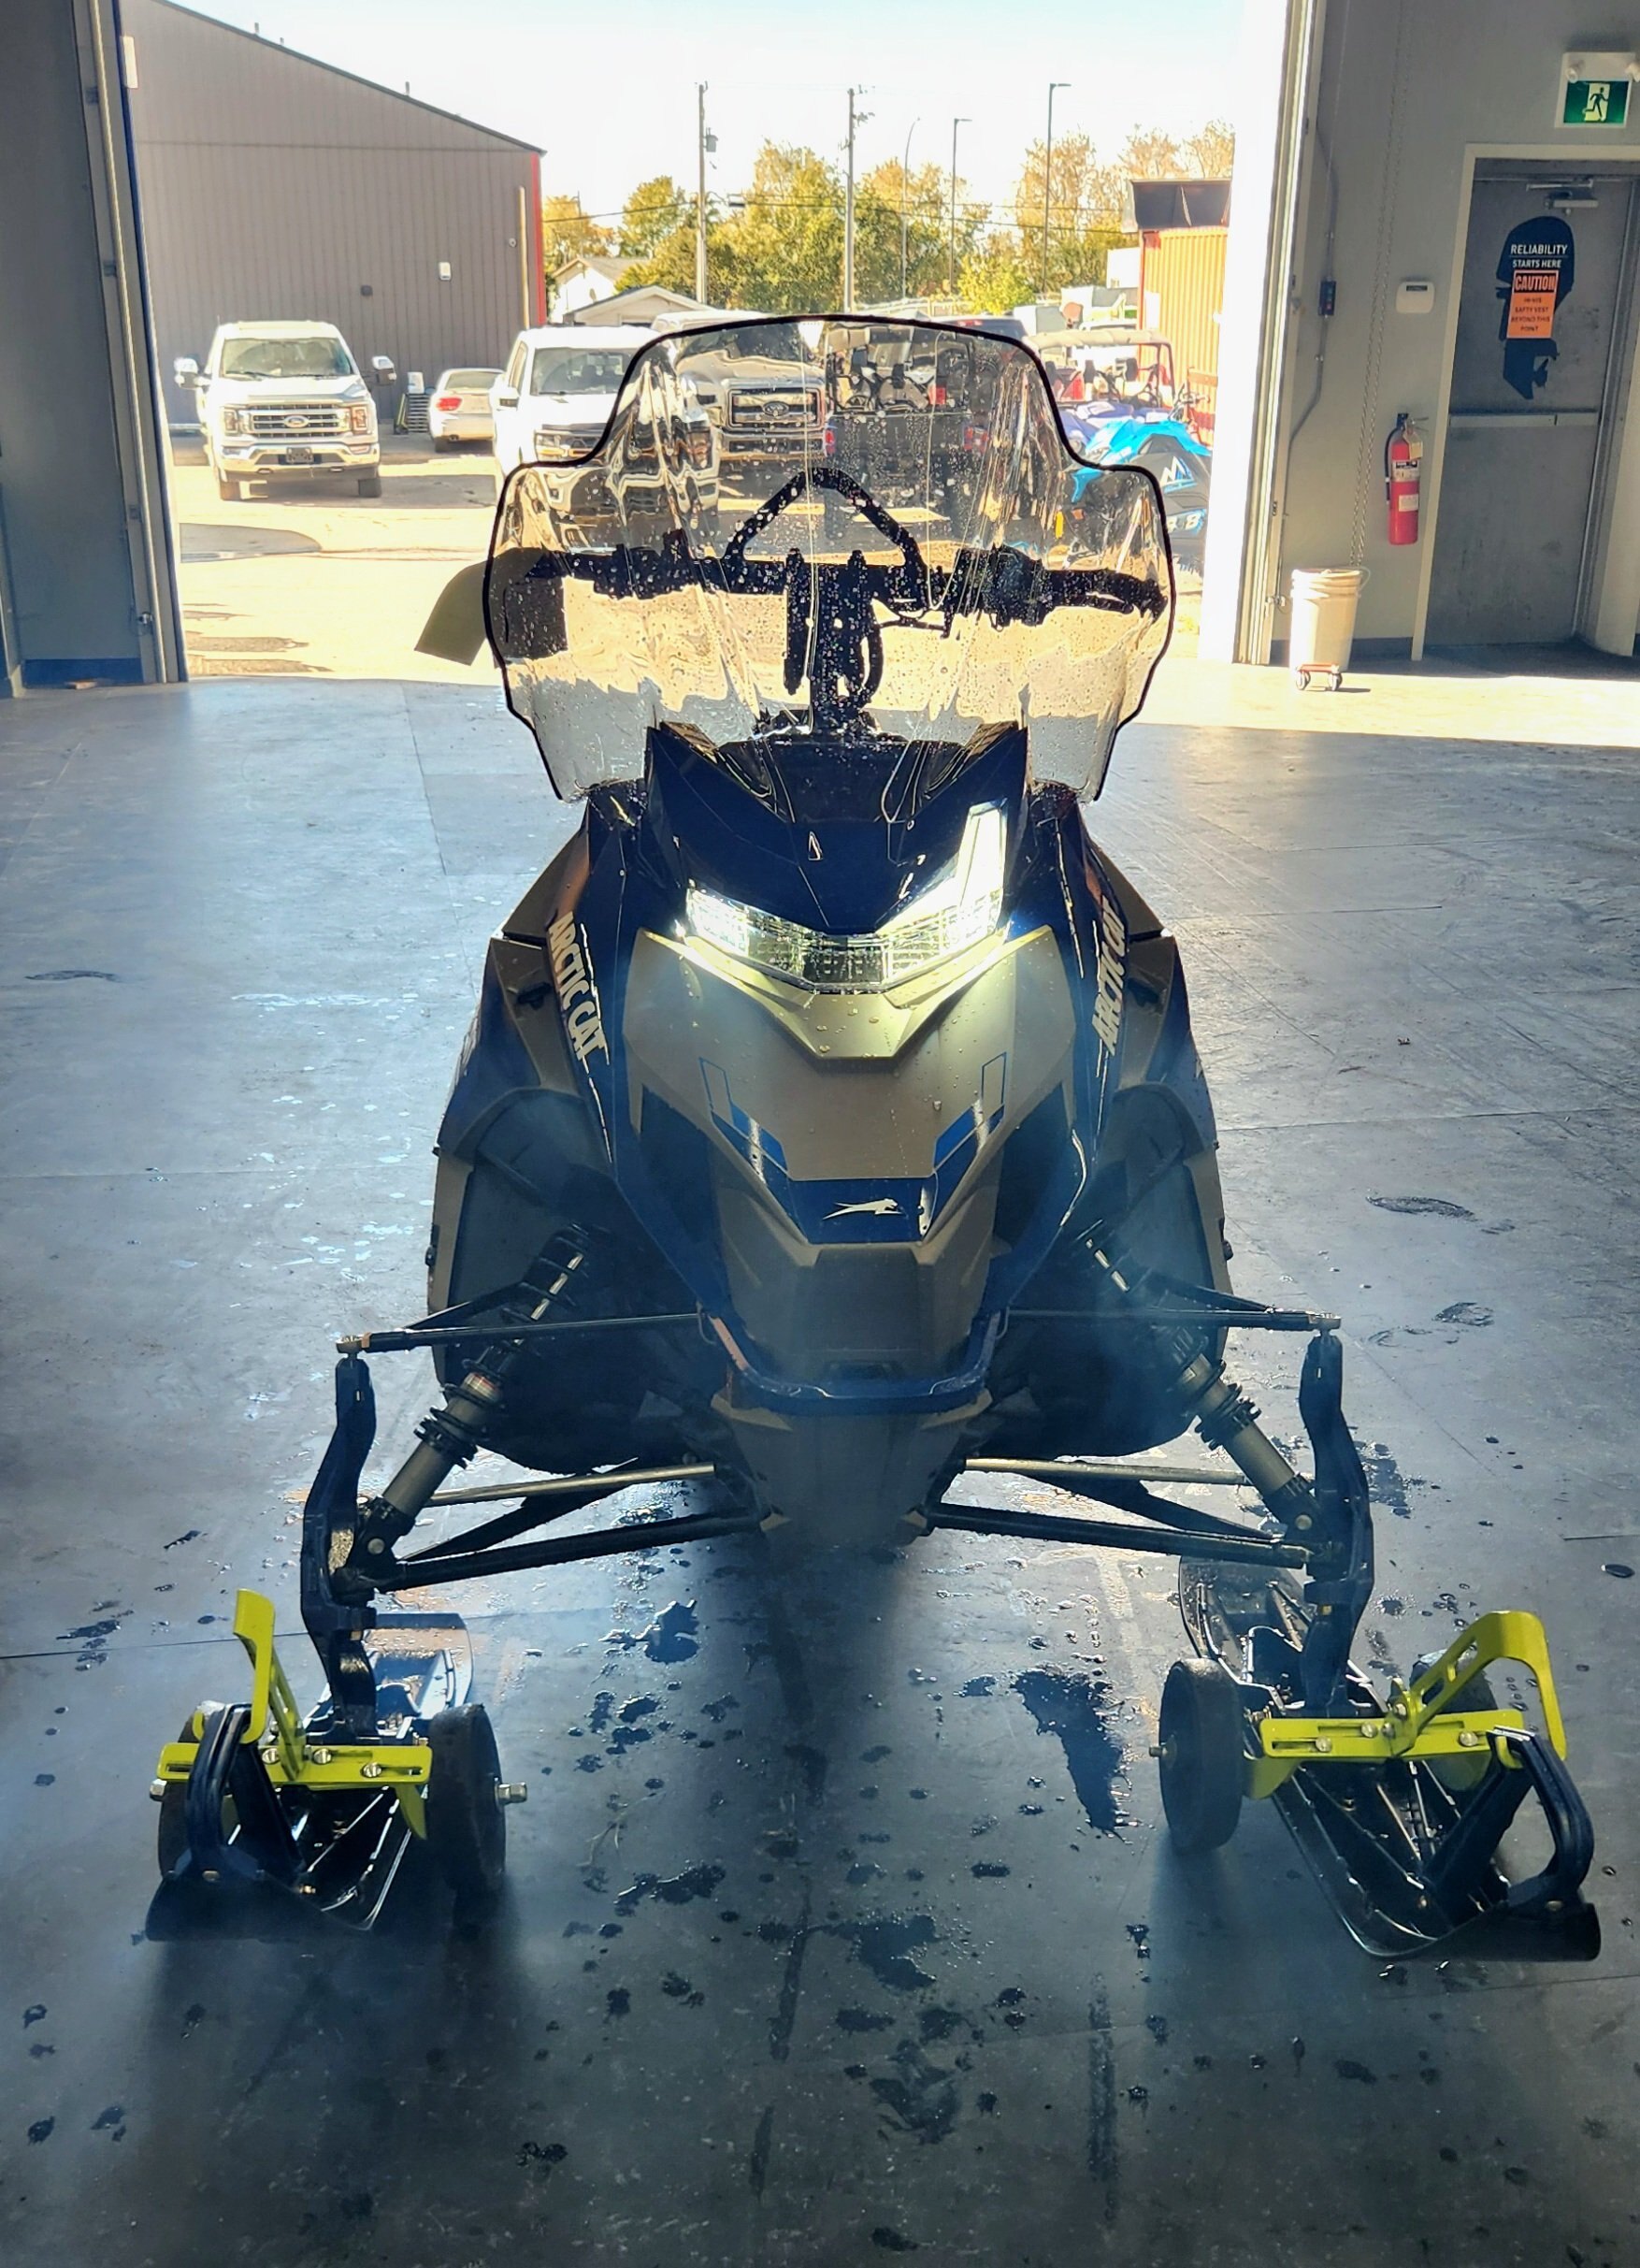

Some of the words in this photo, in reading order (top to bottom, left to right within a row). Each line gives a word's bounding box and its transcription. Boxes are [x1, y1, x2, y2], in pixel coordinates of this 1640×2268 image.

[1510, 244, 1568, 254] RELIABILITY
[1512, 259, 1541, 268] STARTS
[1541, 259, 1562, 268] HERE
[1515, 275, 1556, 291] CAUTION
[1101, 894, 1126, 958] CAT
[548, 910, 590, 1011] ARCTIC
[1091, 940, 1125, 1057] ARCTIC
[568, 1000, 606, 1061] CAT
